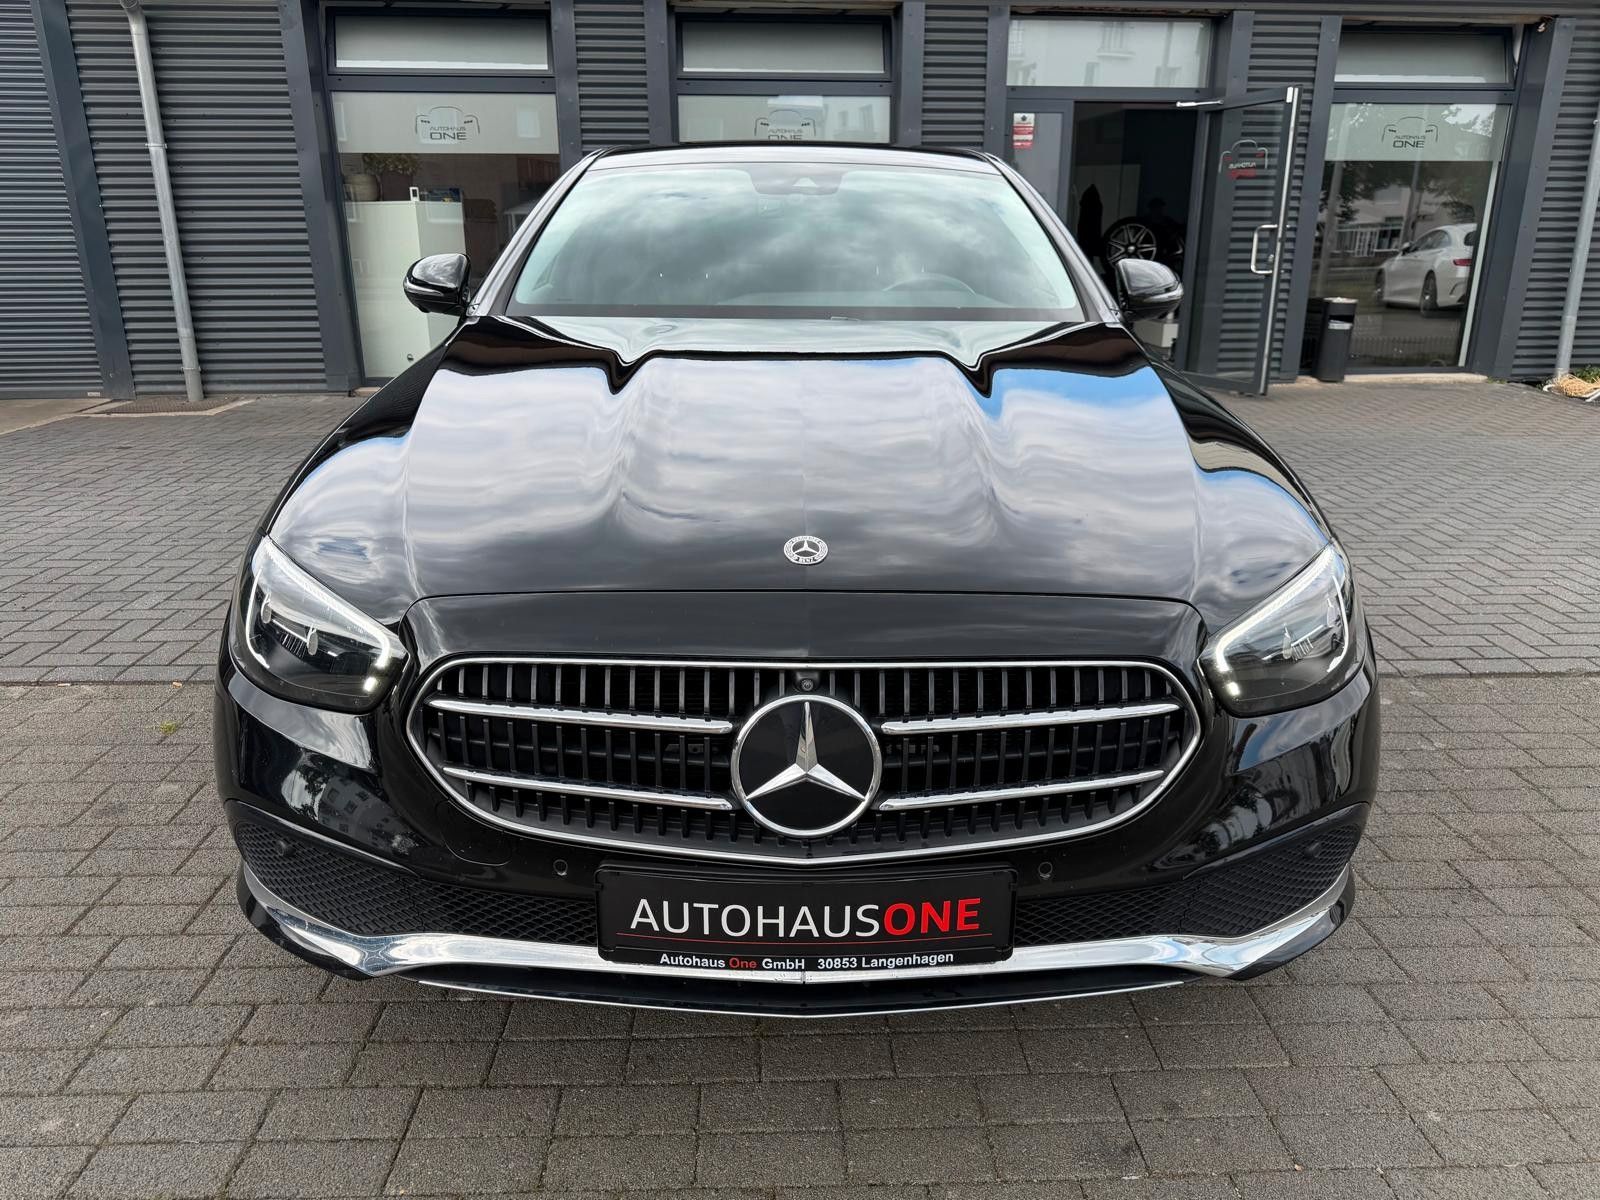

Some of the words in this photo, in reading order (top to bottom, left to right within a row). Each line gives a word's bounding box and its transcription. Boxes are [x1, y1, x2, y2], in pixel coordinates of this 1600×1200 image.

[430, 132, 467, 140] ONE
[1393, 140, 1425, 148] ONE
[660, 953, 726, 969] Autohaus
[729, 957, 758, 969] One
[762, 958, 806, 970] GmbH
[817, 957, 858, 970] 30853
[862, 953, 954, 971] Langenhagen
